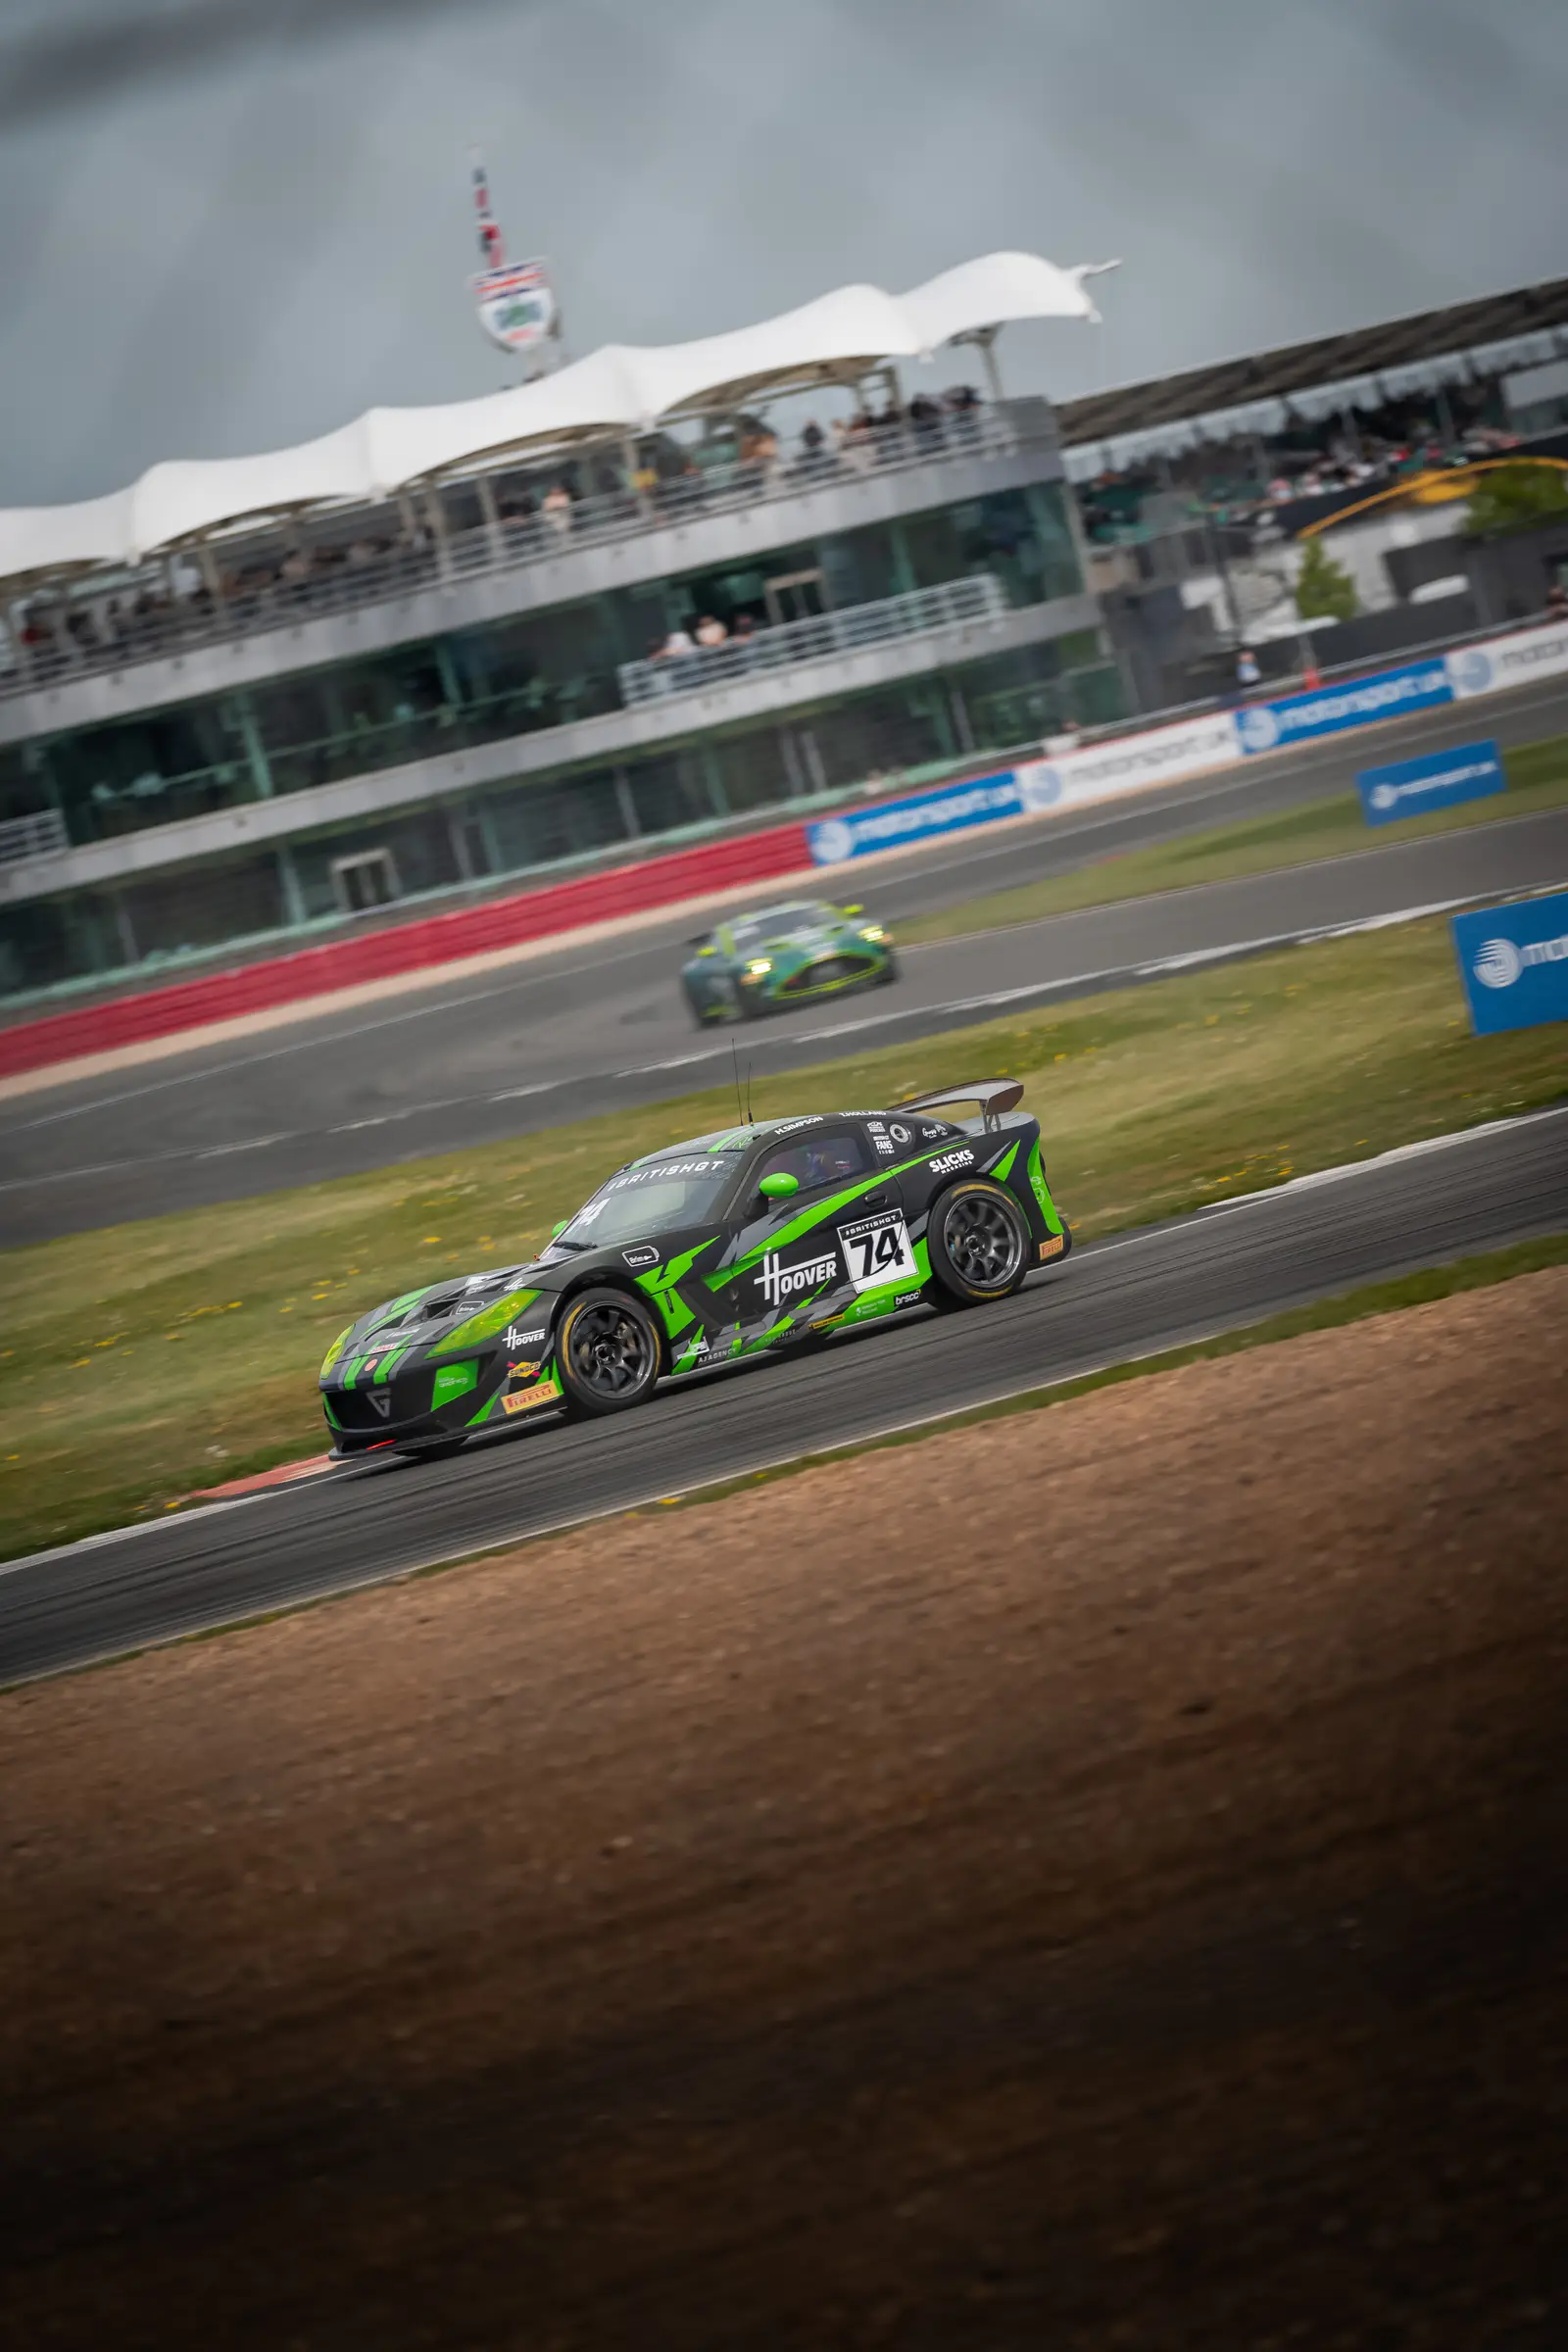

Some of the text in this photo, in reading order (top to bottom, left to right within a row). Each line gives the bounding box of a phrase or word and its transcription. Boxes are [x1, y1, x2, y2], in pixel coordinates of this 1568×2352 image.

[774, 1116, 824, 1135] H.SIMPSON
[929, 1149, 974, 1173] SLICKS
[849, 1227, 906, 1278] 74
[754, 1247, 838, 1306] HOOVER
[502, 1325, 545, 1350] HOOVER
[508, 1360, 542, 1379] SUNOCO
[506, 1384, 552, 1409] PIRELLI
